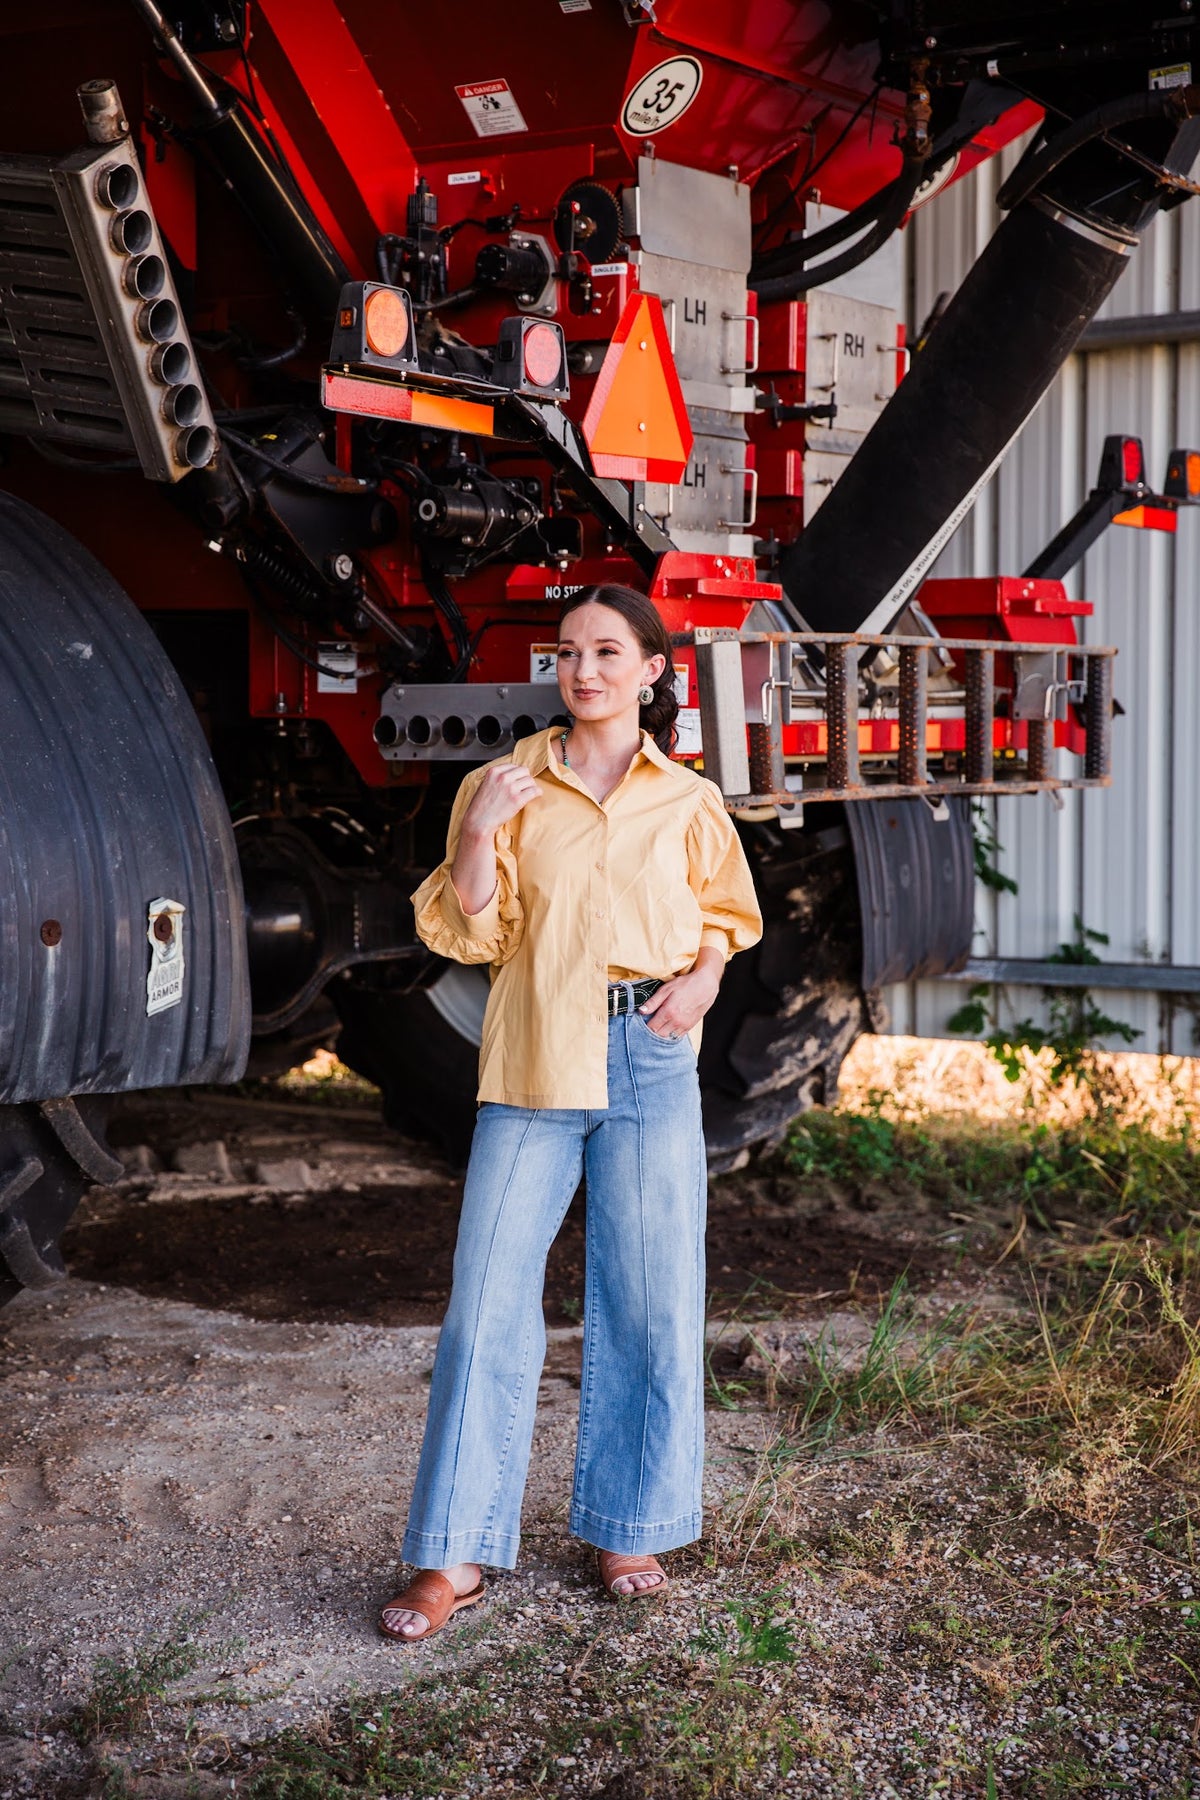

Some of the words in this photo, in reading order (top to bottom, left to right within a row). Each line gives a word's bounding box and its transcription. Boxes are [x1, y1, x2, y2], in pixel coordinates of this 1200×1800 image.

[473, 83, 504, 95] DANGER
[643, 78, 685, 113] 35
[684, 297, 706, 325] LH
[844, 333, 864, 358] RH
[684, 462, 706, 488] LH
[545, 585, 562, 599] NO
[892, 589, 905, 603] PSI
[152, 982, 179, 1002] ARMOR
